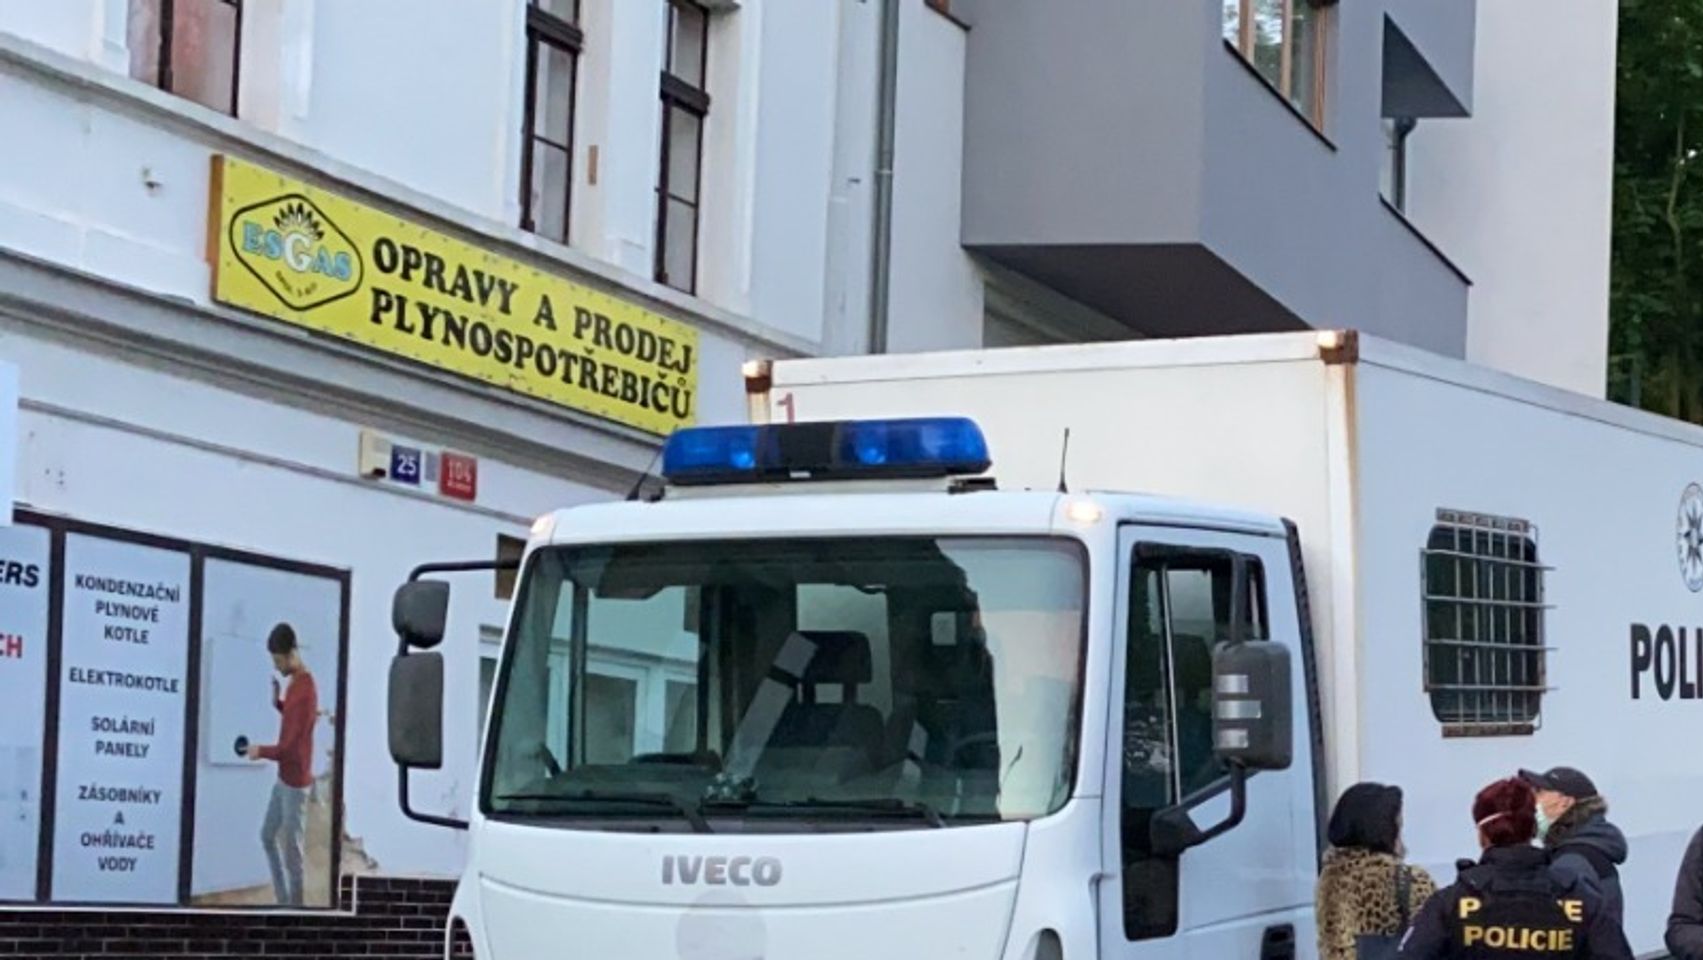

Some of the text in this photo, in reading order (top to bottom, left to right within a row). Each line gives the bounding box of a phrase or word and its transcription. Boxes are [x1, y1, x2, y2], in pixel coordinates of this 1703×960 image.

[242, 219, 352, 282] ESGAS
[373, 236, 519, 316] OPRAVY
[533, 294, 558, 331] A
[574, 306, 693, 375] PRODEJ
[370, 286, 692, 419] PLYNOSPOTŘEBIČŮ
[397, 455, 417, 476] 25
[74, 574, 180, 603] KONDENZAČNÍ
[95, 599, 159, 623] PLYNOVÉ
[104, 624, 149, 645] KOTLE
[69, 666, 179, 693] ELEKTROKOTLE
[91, 715, 155, 736] SOLÁRNÍ
[95, 739, 150, 758] PANELY
[78, 782, 161, 805] ZÁSOBNÍKY
[114, 810, 125, 825] A
[80, 828, 155, 849] OHŘÍVAČE
[98, 855, 137, 872] VODY
[661, 855, 783, 887] IVECO
[1463, 925, 1573, 951] POLICIE
